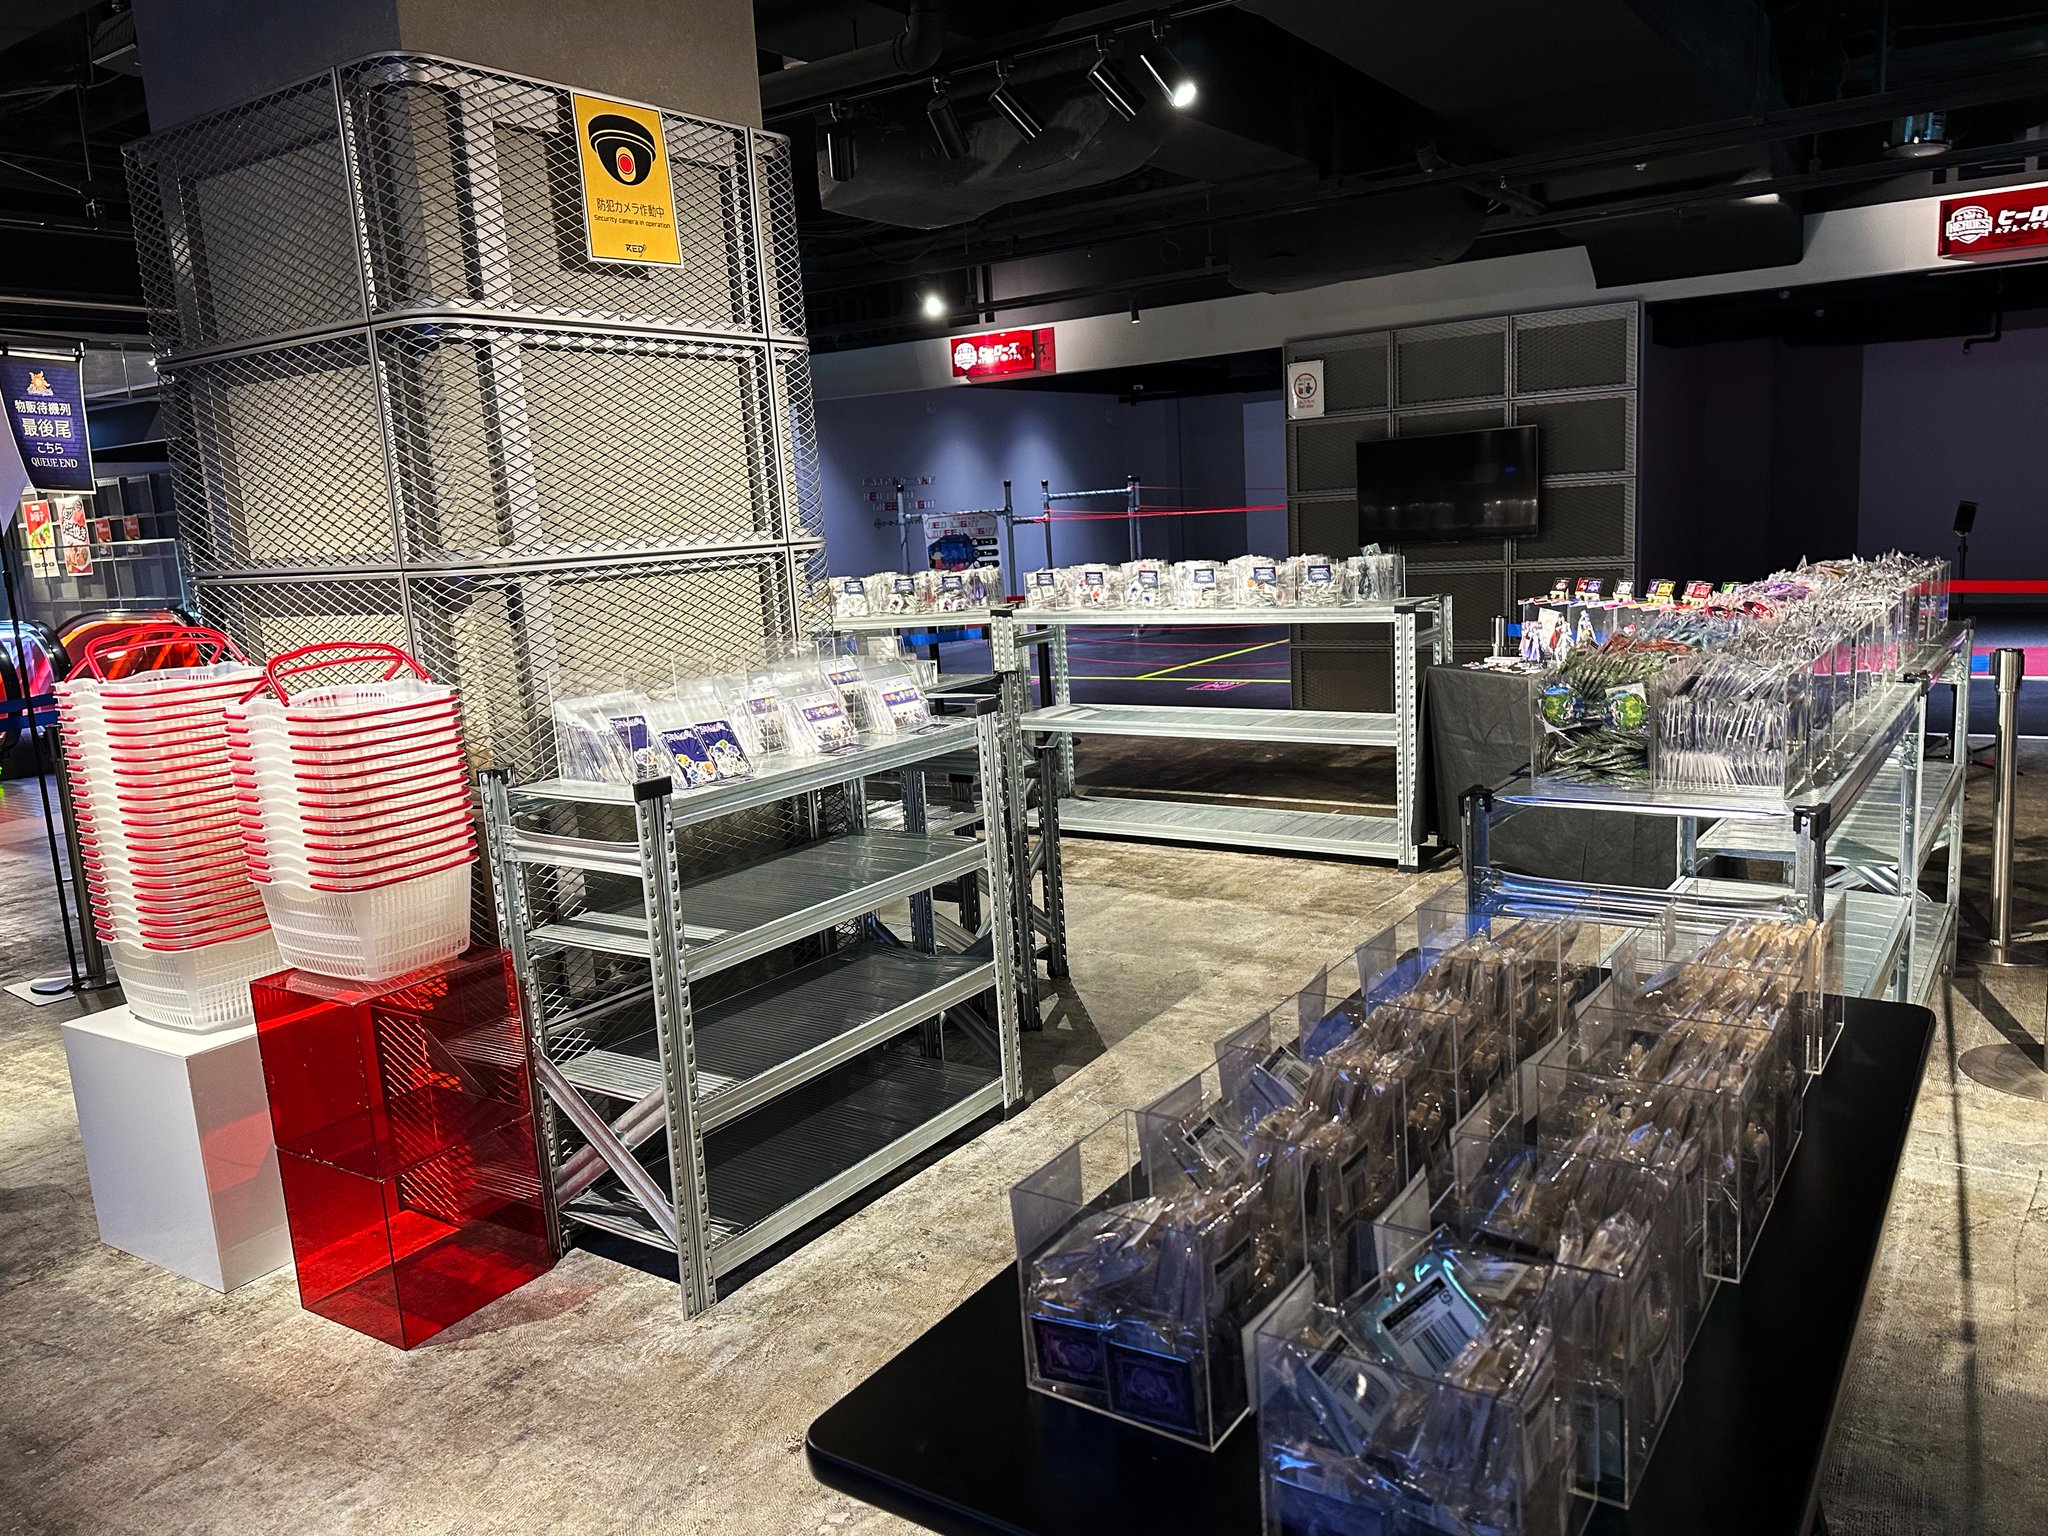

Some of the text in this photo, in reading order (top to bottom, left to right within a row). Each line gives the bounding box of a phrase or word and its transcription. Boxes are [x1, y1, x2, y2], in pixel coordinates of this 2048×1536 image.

[596, 198, 664, 218] 防犯カメラ作動中
[593, 214, 617, 224] Security
[618, 217, 639, 226] camera
[645, 221, 671, 229] operation
[15, 400, 71, 416] 物販待機列
[22, 418, 72, 438] 最後尾
[37, 442, 64, 454] こちら
[31, 457, 78, 468] QUEUE END
